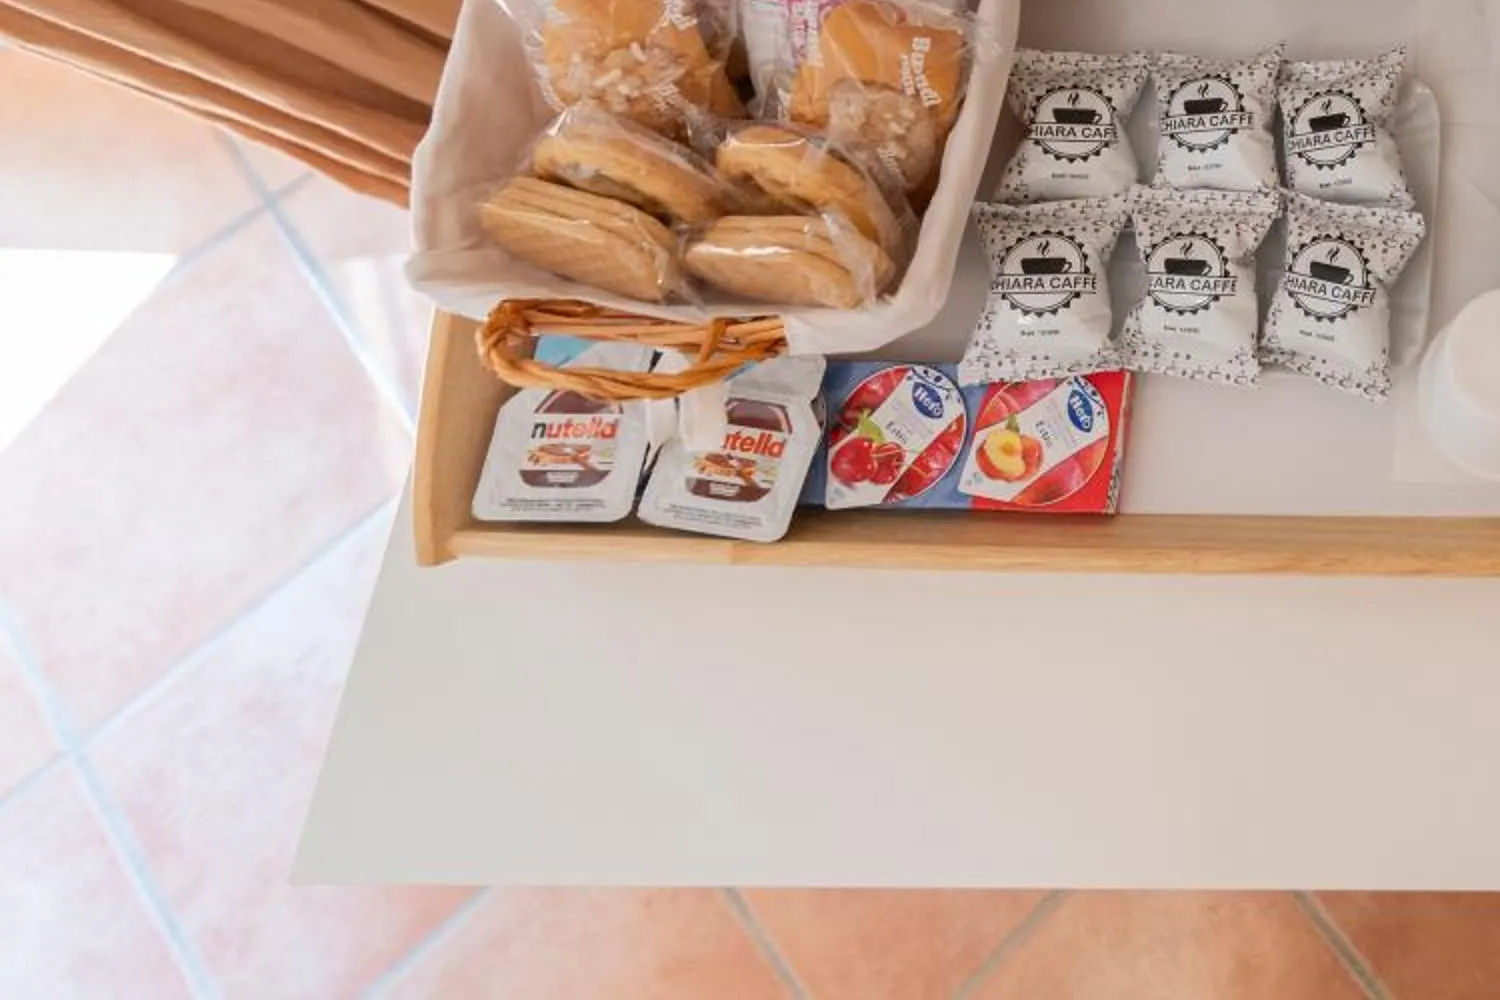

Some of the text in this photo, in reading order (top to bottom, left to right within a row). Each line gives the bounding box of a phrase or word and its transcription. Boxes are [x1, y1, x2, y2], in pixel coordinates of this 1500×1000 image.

[1030, 124, 1077, 138] HIARA
[1163, 117, 1206, 131] HIARA
[1285, 275, 1327, 296] HIARA
[914, 386, 943, 418] Hero
[1069, 395, 1092, 430] Hero
[530, 417, 619, 440] nutella
[724, 430, 787, 459] tella
